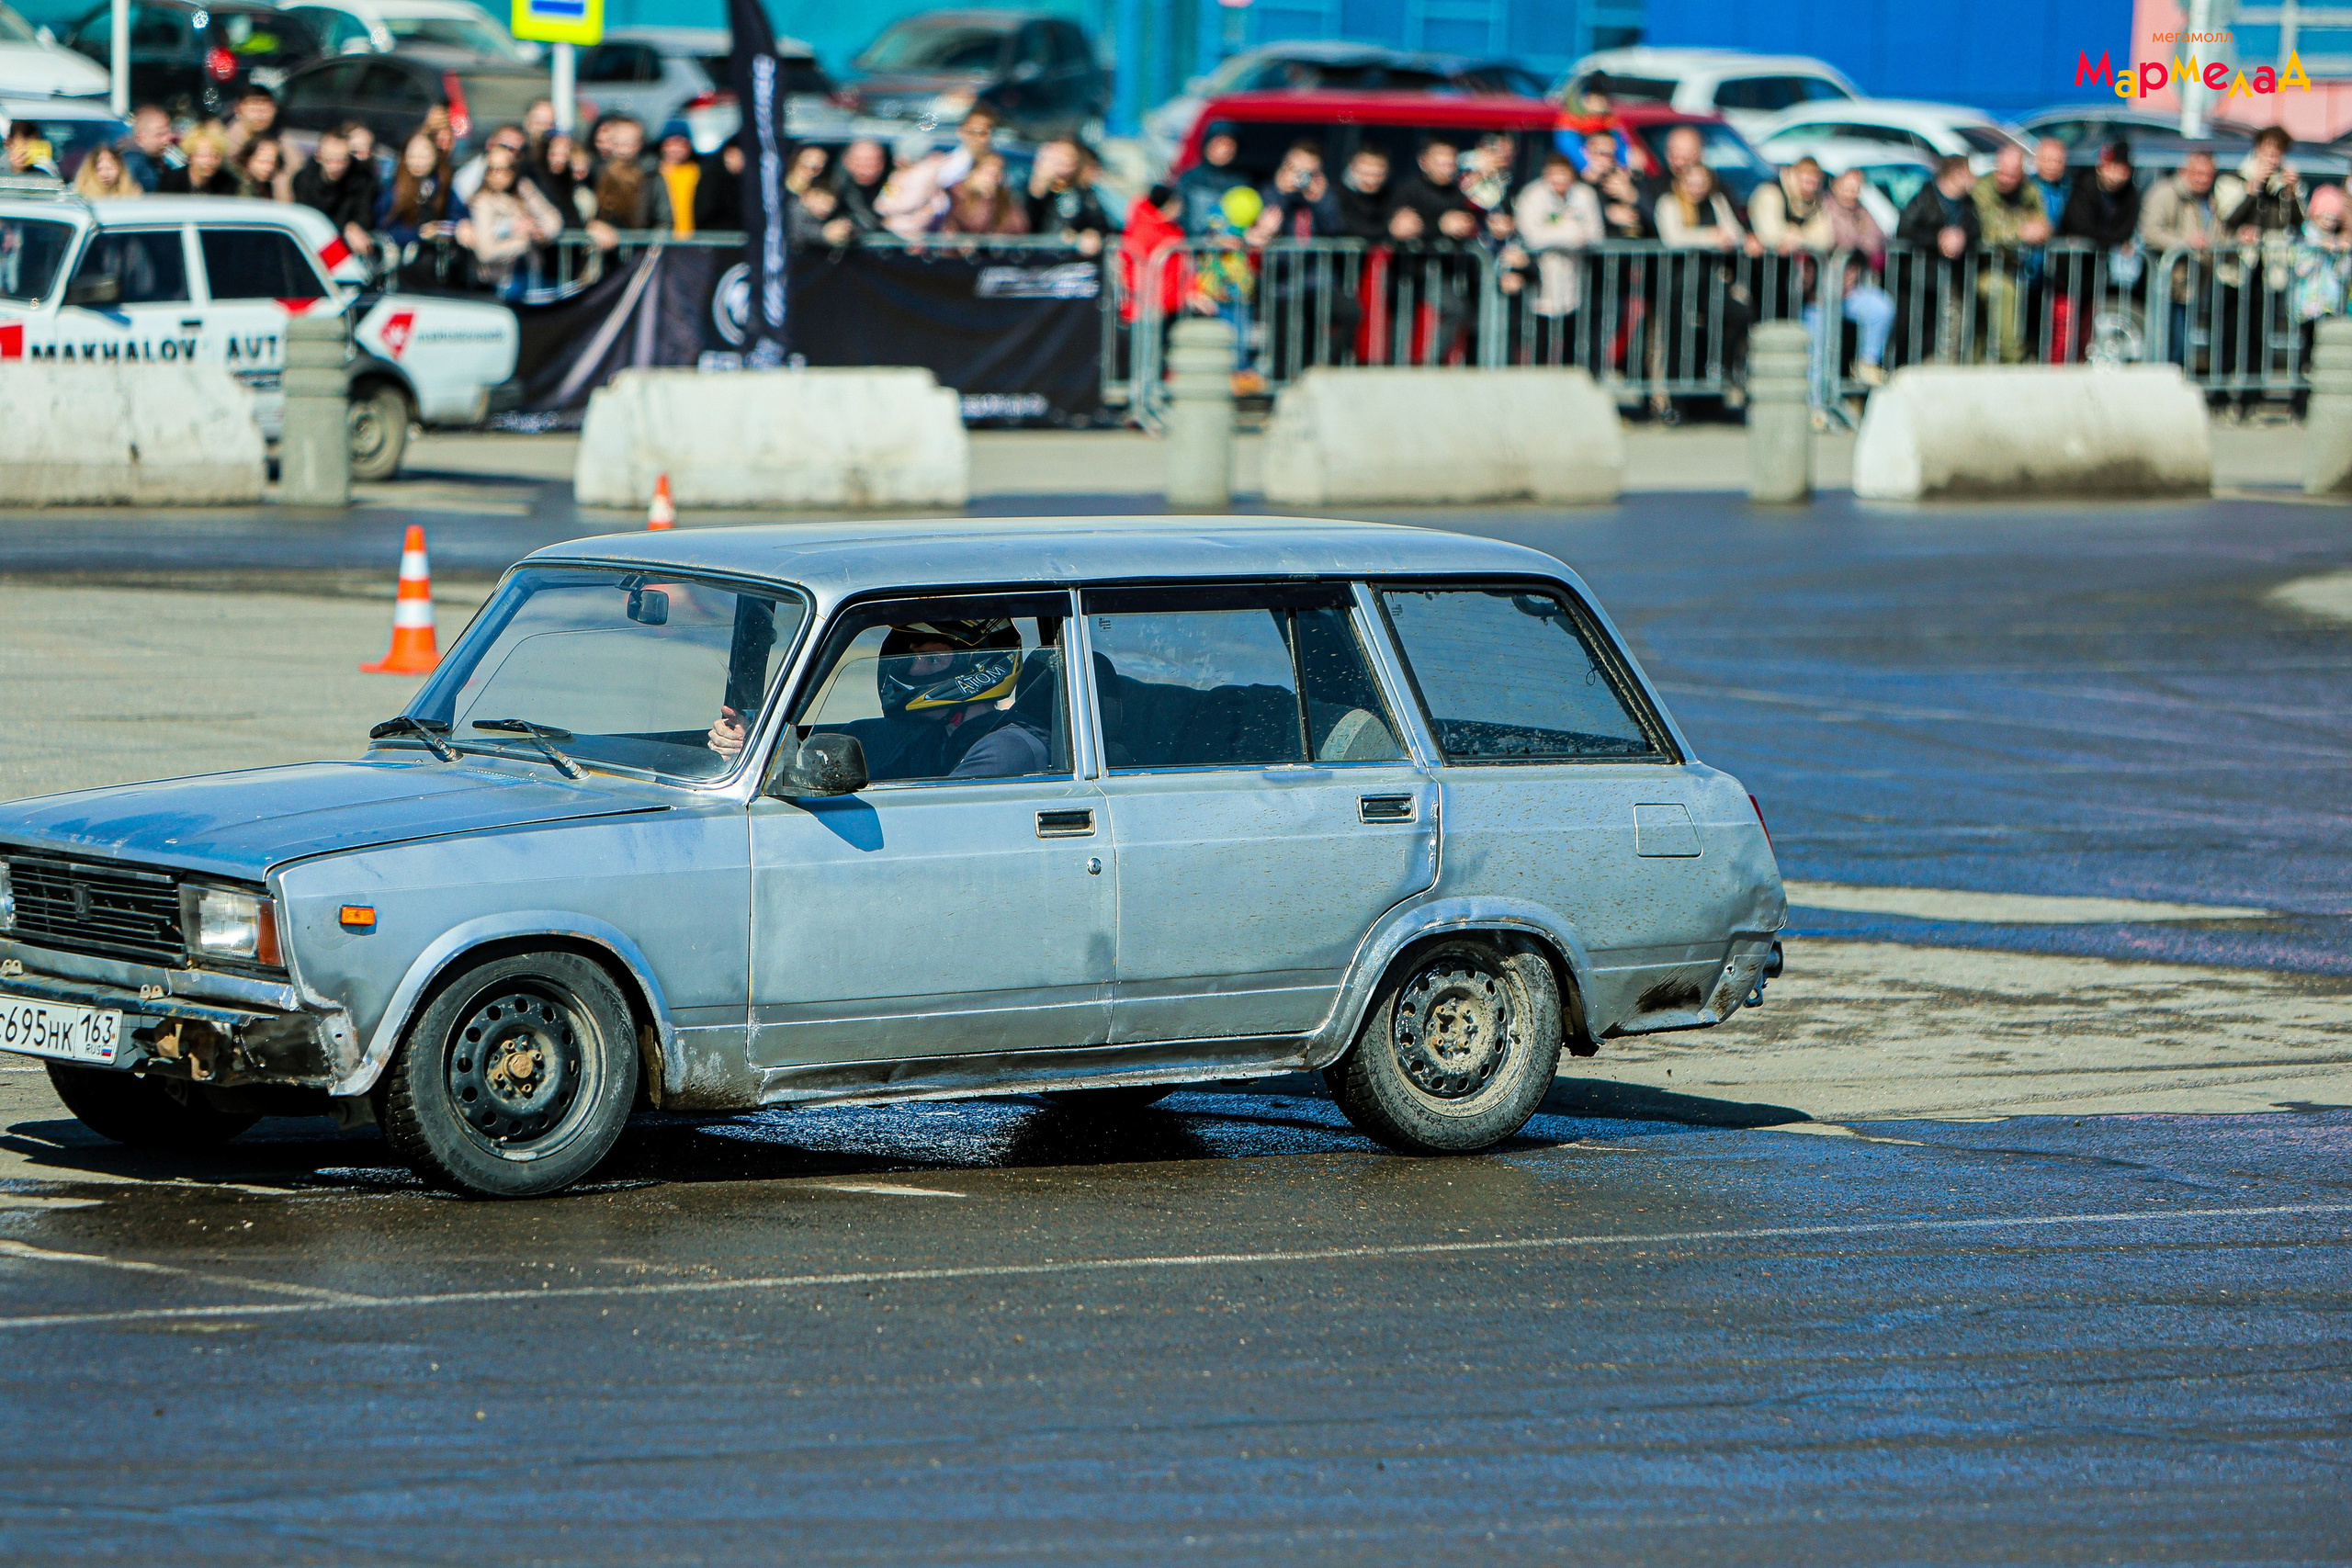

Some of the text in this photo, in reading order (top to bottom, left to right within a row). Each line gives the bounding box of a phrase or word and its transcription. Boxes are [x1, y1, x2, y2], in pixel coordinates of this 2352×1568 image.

[30, 337, 197, 364] MAKHALOV
[956, 665, 1008, 694] ATOM
[81, 1013, 113, 1043] 163
[85, 1043, 102, 1055] RUS
